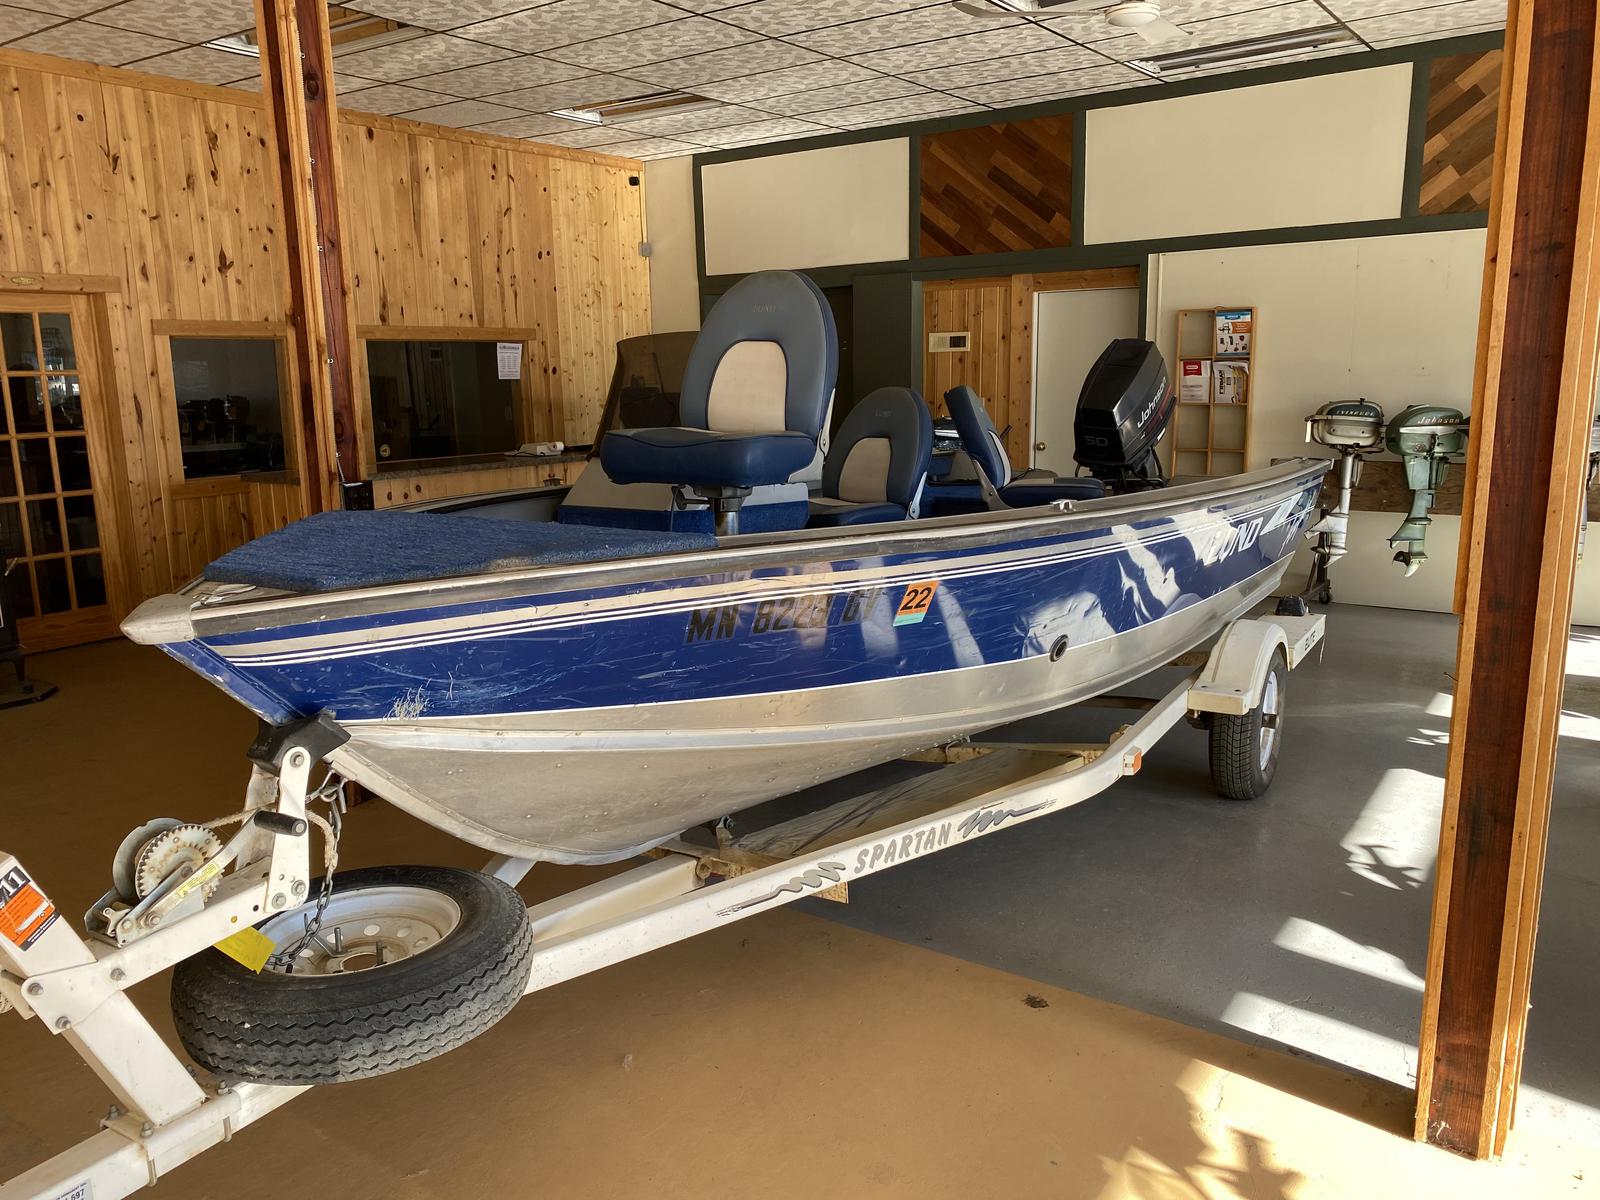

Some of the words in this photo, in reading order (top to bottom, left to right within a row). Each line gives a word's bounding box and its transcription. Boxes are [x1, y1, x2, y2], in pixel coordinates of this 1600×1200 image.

[1137, 375, 1167, 429] Johnson
[1417, 416, 1460, 425] Johnson
[899, 586, 932, 611] 22
[687, 604, 739, 644] MN
[854, 822, 952, 874] SPARTAN
